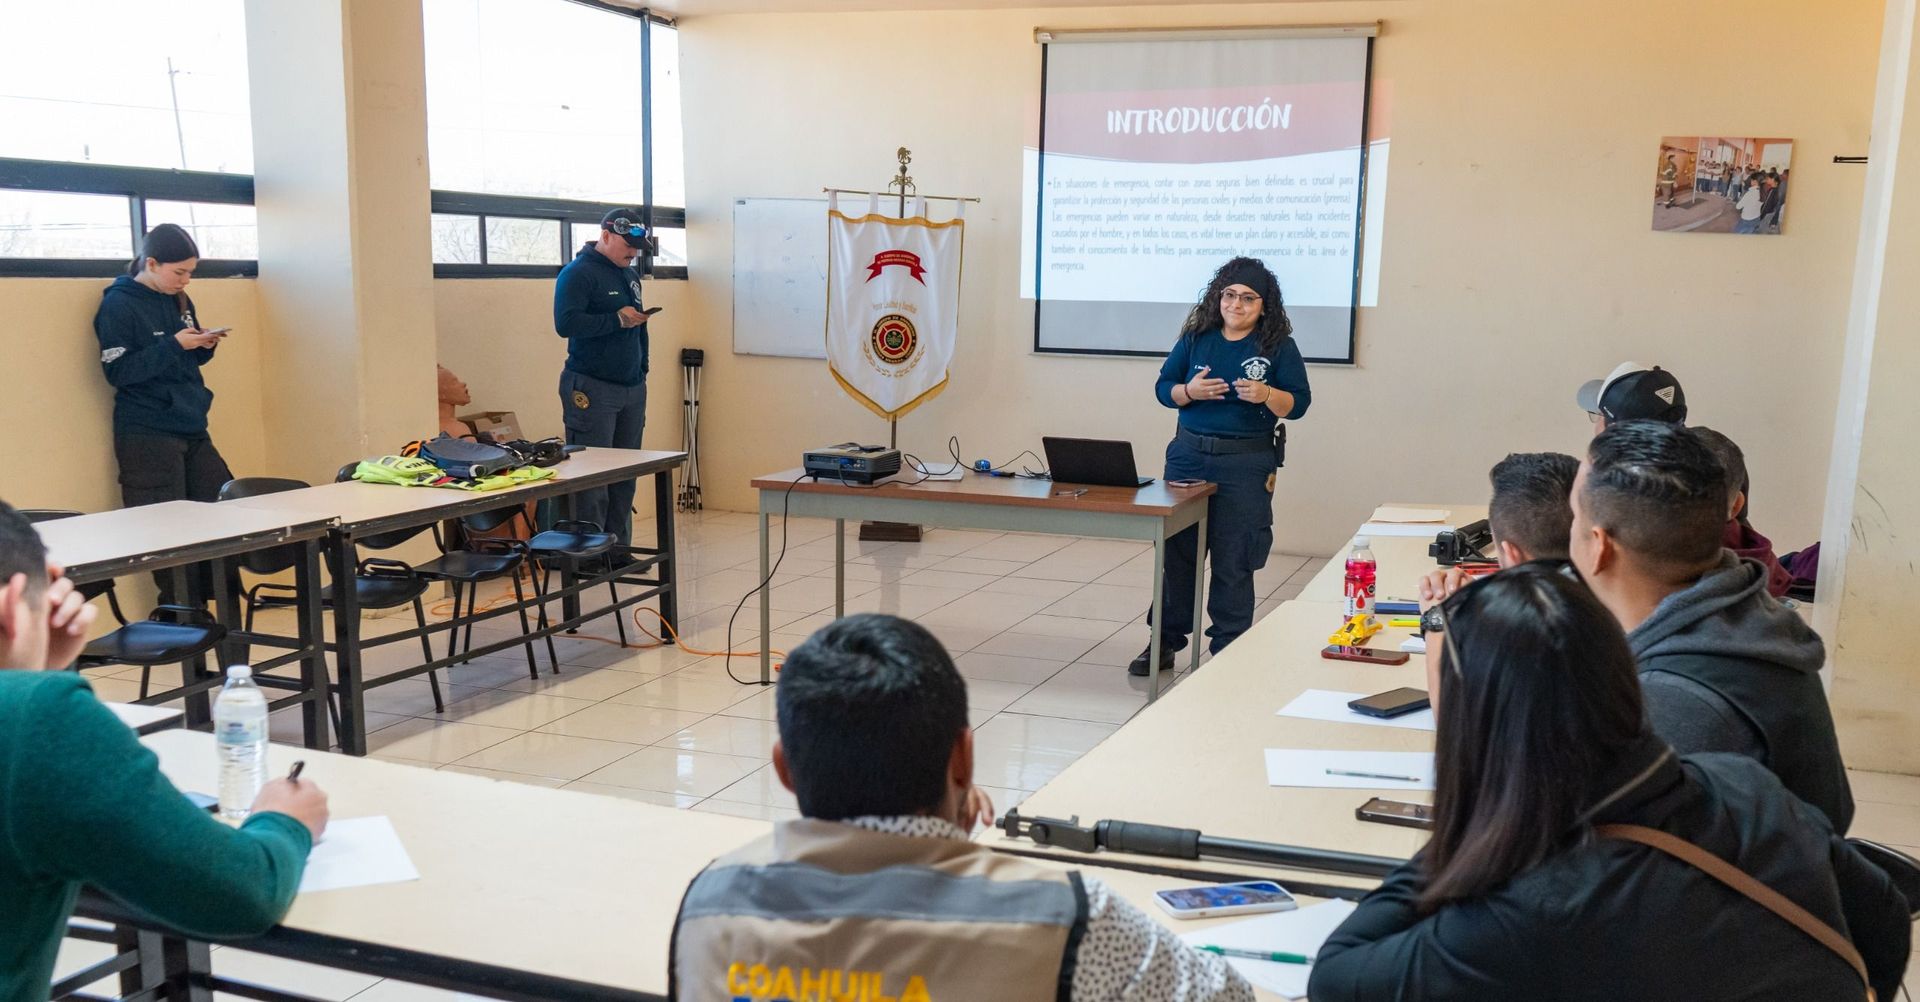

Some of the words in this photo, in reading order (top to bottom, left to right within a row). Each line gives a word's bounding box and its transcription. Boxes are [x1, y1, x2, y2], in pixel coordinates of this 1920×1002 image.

[1107, 97, 1292, 135] INTRODUCCIÓN
[1053, 177, 1061, 188] En
[1065, 178, 1097, 188] situaciones
[1102, 176, 1110, 188] de
[1154, 179, 1174, 187] contar
[1216, 180, 1240, 191] seguras
[1246, 175, 1260, 186] bien
[1265, 173, 1294, 185] definidas
[1312, 173, 1334, 185] crucial
[1339, 177, 1353, 188] para
[1053, 194, 1081, 208] garantizar
[1083, 193, 1088, 204] la
[1124, 198, 1127, 207] y
[1130, 192, 1159, 207] seguridad
[1161, 192, 1169, 204] de
[1171, 192, 1179, 204] las
[1182, 197, 1209, 207] personas
[1211, 192, 1230, 204] civiles
[1232, 197, 1237, 206] y
[1239, 192, 1263, 204] medios
[1266, 192, 1274, 204] de
[1053, 210, 1062, 222] Las
[1066, 214, 1102, 224] emergencias
[1106, 210, 1129, 224] pueden
[1133, 213, 1150, 221] variar
[1203, 210, 1221, 221] desde
[1226, 210, 1256, 221] desastres
[1260, 210, 1290, 221] naturales
[1295, 209, 1312, 221] hasta
[1317, 209, 1351, 221] incidentes
[1052, 226, 1078, 238] causados
[1080, 231, 1088, 240] por
[1092, 226, 1097, 238] el
[1126, 231, 1130, 240] y
[1143, 226, 1159, 238] todos
[1161, 226, 1170, 238] los
[1201, 226, 1213, 238] vital
[1216, 228, 1231, 238] tener
[1246, 227, 1259, 241] plan
[1261, 226, 1278, 238] claro
[1279, 231, 1284, 242] y
[1079, 243, 1085, 254] el
[1088, 244, 1127, 254] conocimiento
[1131, 243, 1139, 254] de
[1143, 243, 1151, 254] los
[1178, 247, 1191, 257] para
[1196, 245, 1237, 255] acercamiento
[1241, 248, 1245, 256] y
[1249, 247, 1291, 257] permanencia
[1296, 244, 1304, 256] de
[1308, 244, 1317, 256] las
[1340, 244, 1348, 256] de
[727, 962, 932, 1002] COAHUILA
